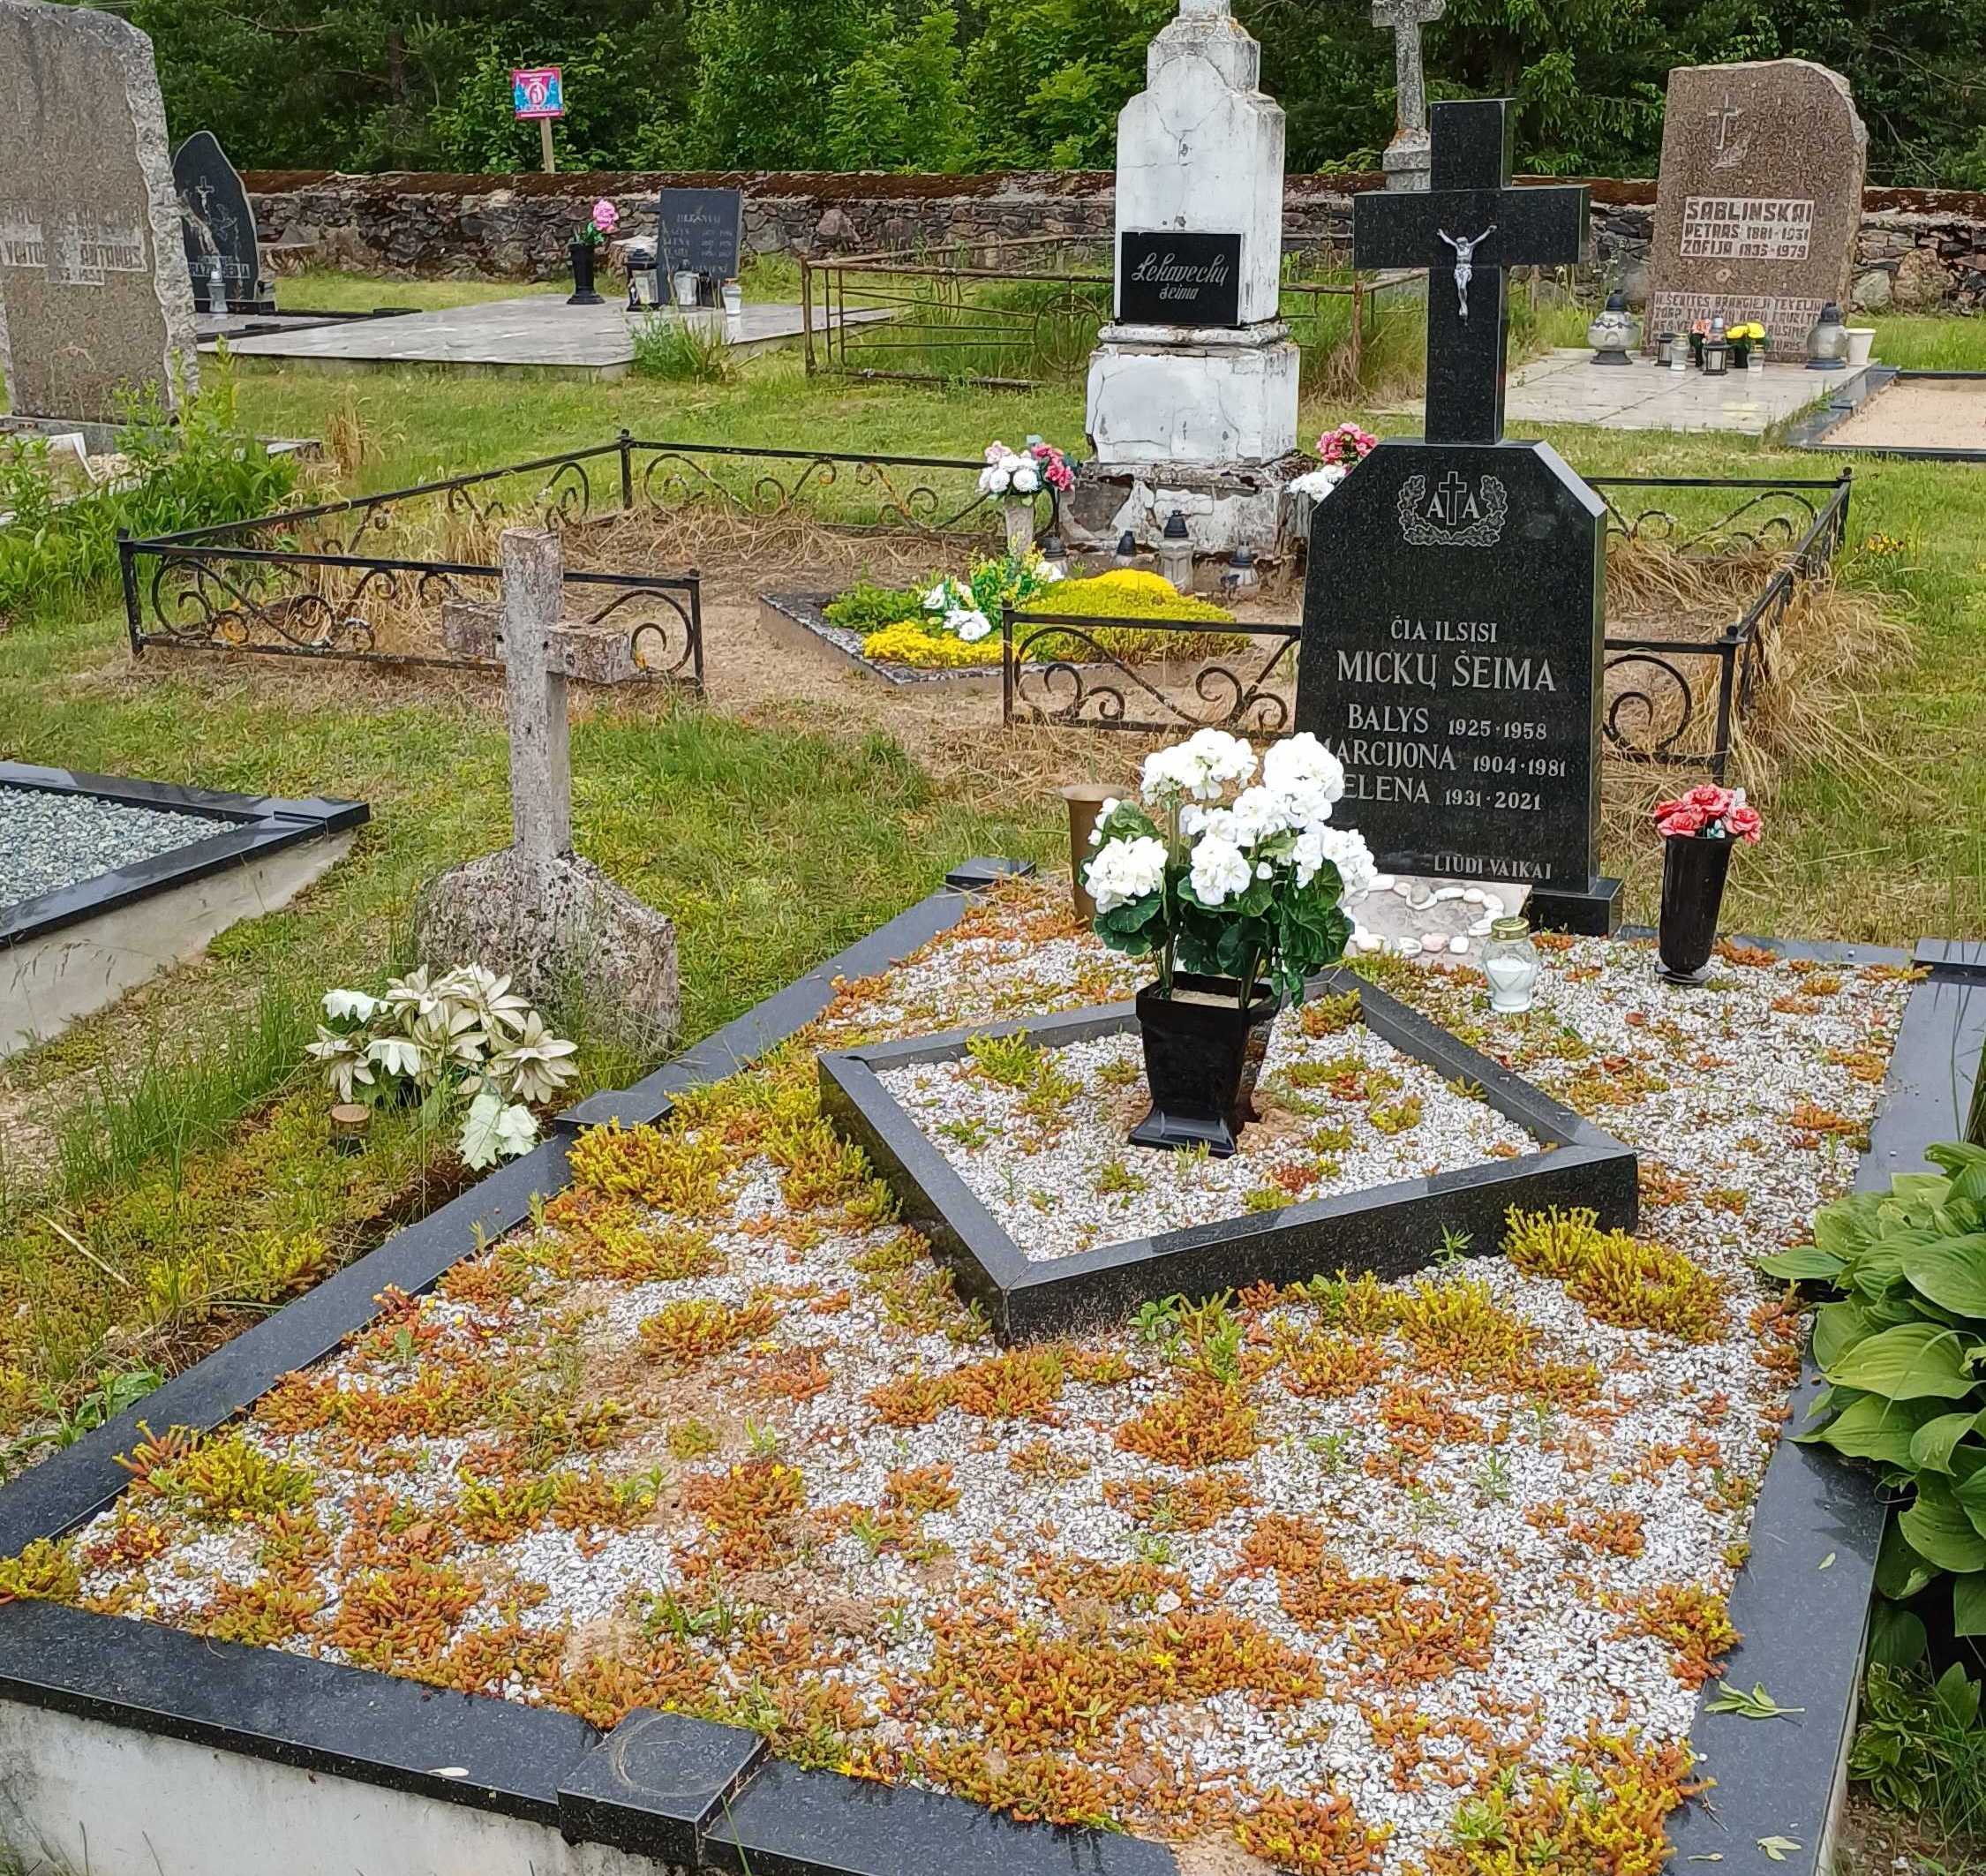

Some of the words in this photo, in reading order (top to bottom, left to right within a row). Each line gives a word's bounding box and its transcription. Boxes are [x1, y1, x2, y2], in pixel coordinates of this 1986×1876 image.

[1390, 615, 1427, 641] ČIA
[1435, 621, 1498, 644] ILSISI
[1336, 649, 1437, 690] MICKŲ
[1452, 649, 1557, 692] ŠEIMA
[1348, 703, 1430, 735] BALYS
[1489, 858, 1552, 880] VAIKAI
